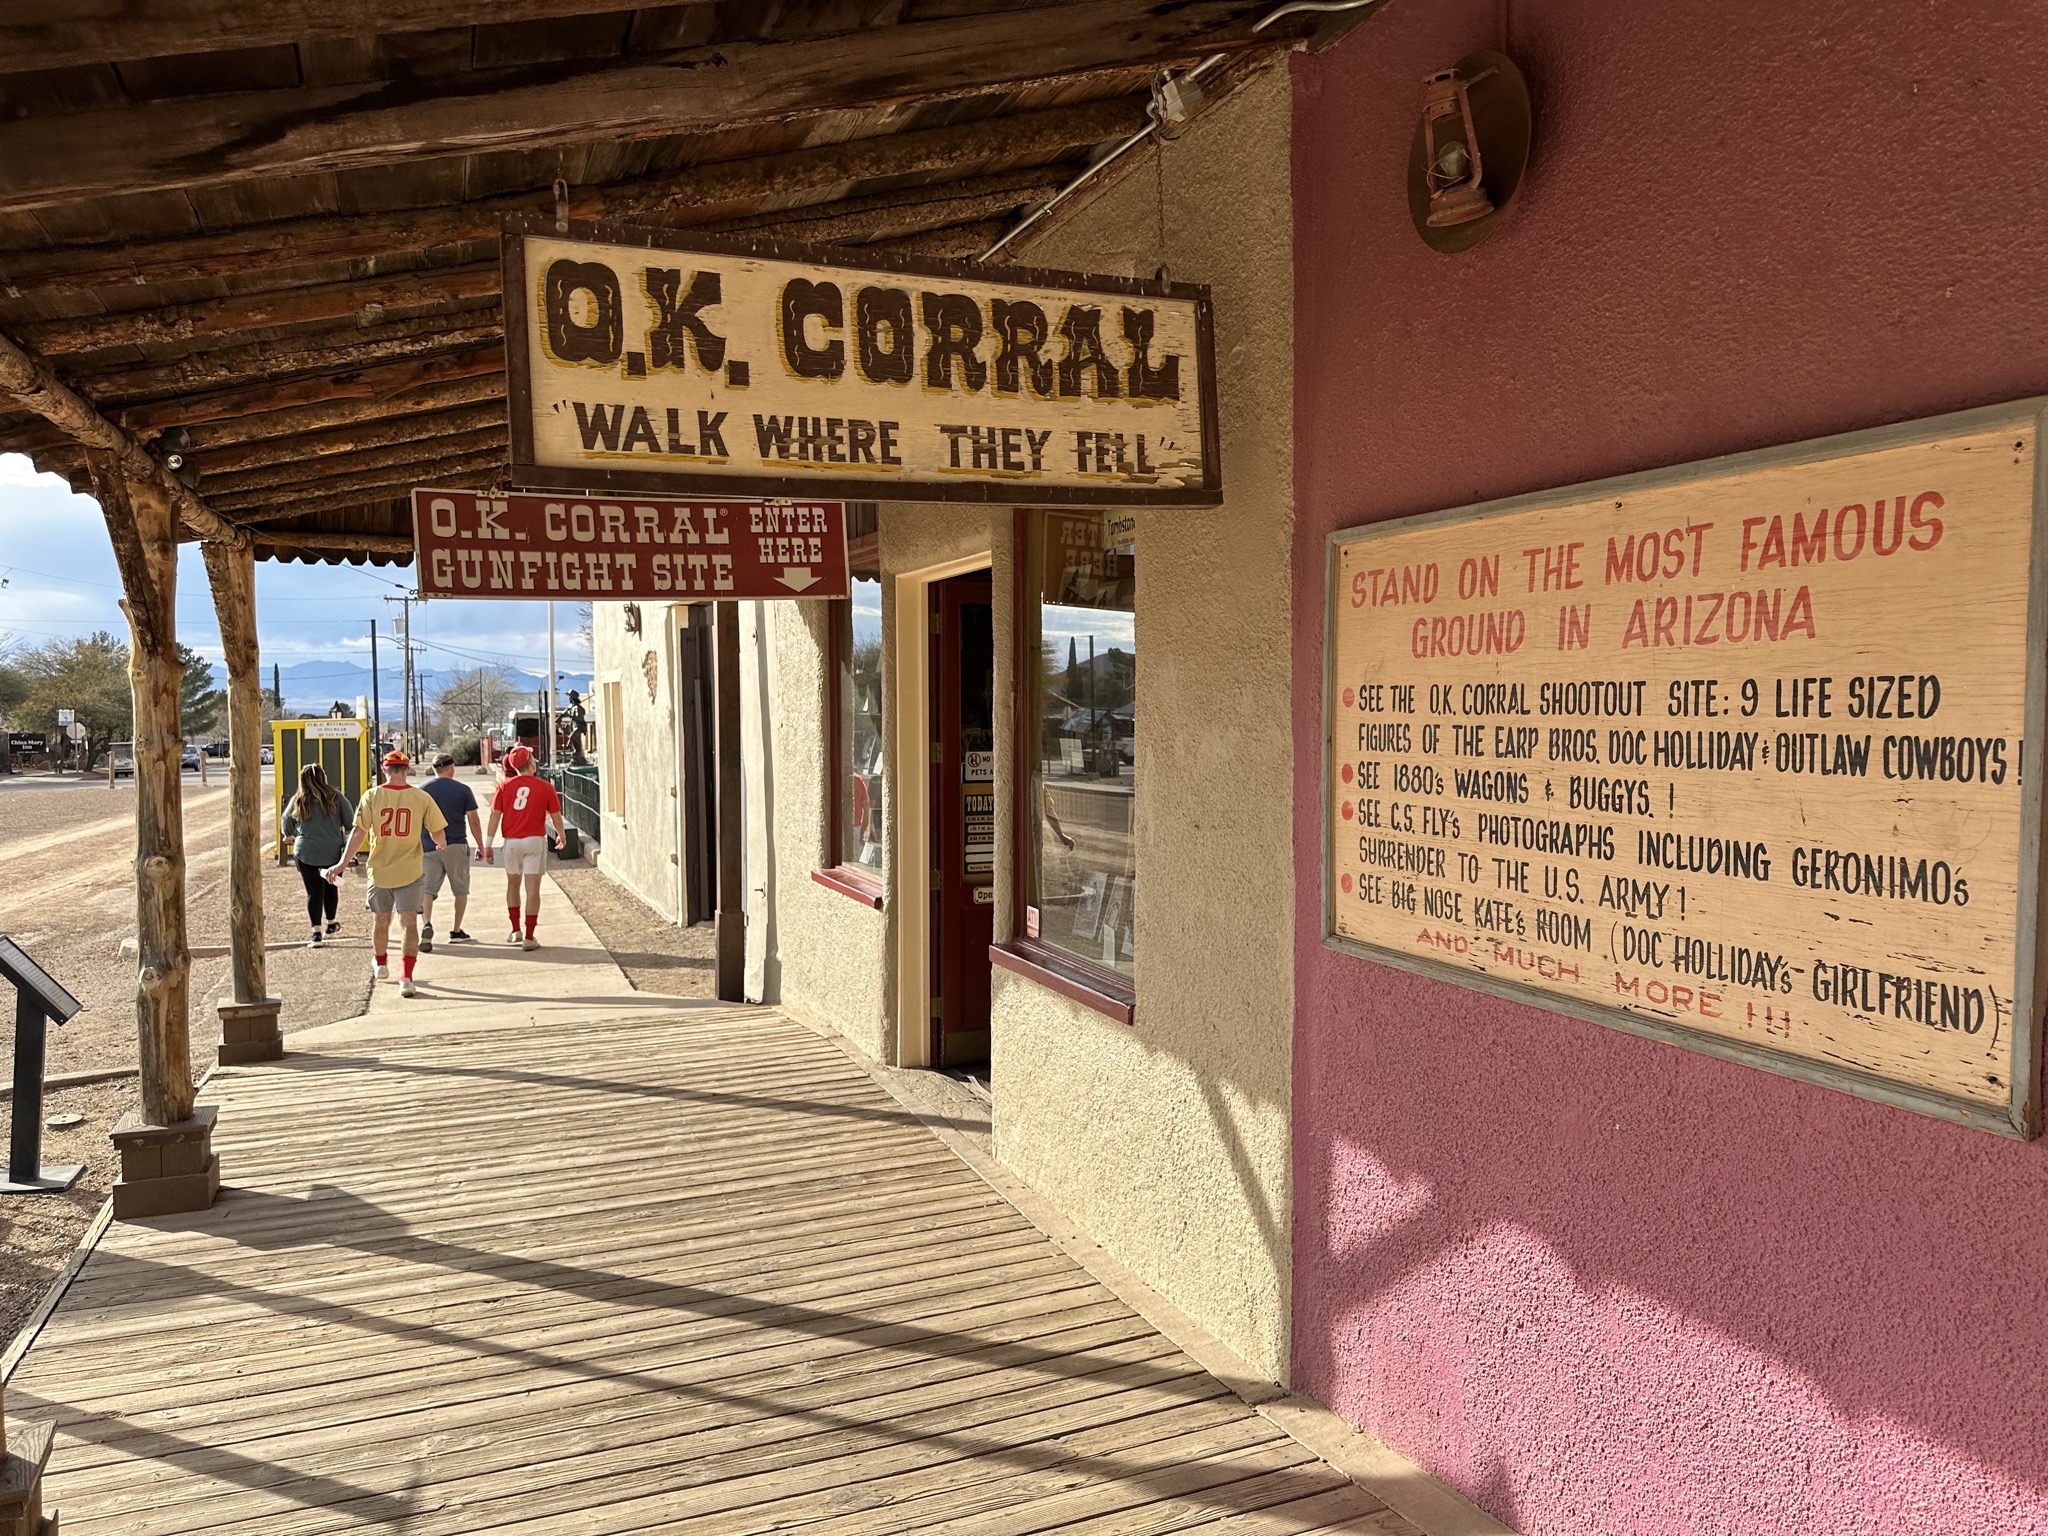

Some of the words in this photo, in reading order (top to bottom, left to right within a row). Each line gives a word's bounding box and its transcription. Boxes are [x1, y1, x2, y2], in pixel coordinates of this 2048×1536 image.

[538, 257, 750, 390] O.K.
[776, 278, 1181, 404] CORRAL
[753, 414, 901, 466] WHERE
[936, 424, 1052, 472] THEY
[430, 498, 527, 541] O.K.
[749, 507, 829, 534] ENTER
[431, 549, 638, 592] GUNFIGHT
[651, 554, 735, 592] SITE
[758, 537, 823, 564] HERE
[1351, 562, 1439, 609] STAND
[1458, 554, 1500, 600] ON
[1523, 542, 1584, 593] THE
[1605, 522, 1714, 585] MOST
[1740, 491, 1945, 572] FAMOUS
[1411, 609, 1526, 659] GROUND
[1558, 603, 1591, 650] IN
[1621, 585, 1817, 649] ARIZONA
[1358, 684, 1384, 712] SEE
[1390, 684, 1415, 713] THE
[1429, 683, 1457, 716] O.K.
[1462, 683, 1531, 716] CORRAL
[1539, 681, 1646, 716] SHOOTOUT
[1667, 680, 1729, 717] SITE:
[1741, 678, 1759, 717] 9
[1776, 677, 1832, 718] LIFE
[1848, 675, 1941, 719] SIZED
[1358, 723, 1412, 754] FIGURES
[1422, 723, 1440, 754] OF
[1452, 724, 1485, 757] THE
[1495, 725, 1539, 759] EARP
[1548, 727, 1600, 764] BROS.
[1609, 729, 1647, 765] DOC
[1653, 730, 1759, 771] HOLLIDAY
[1776, 732, 1871, 777] OUTLAW
[513, 786, 530, 811] 8
[966, 796, 994, 812] TODAY
[1358, 760, 1381, 789] SEE
[1394, 763, 1444, 795] 1880's
[1454, 768, 1529, 803] WAGONS
[380, 808, 411, 837] 20
[1358, 798, 1381, 828] SEE
[1390, 802, 1416, 834] C.S.
[1423, 806, 1460, 839] FLY's
[1478, 813, 1615, 861] PHOTOGRAPHS
[1638, 830, 1771, 881] INCLUDING
[1792, 847, 1969, 907] GERONIMO's
[1359, 835, 1446, 878] SURRENDER
[1458, 852, 1480, 884] TO
[1492, 857, 1529, 893] THE
[1544, 864, 1584, 904] U.S.
[1359, 872, 1383, 905] SEE
[1391, 880, 1416, 913] BIG
[1424, 886, 1463, 923] NOSE
[1474, 897, 1526, 936] KATE's
[1536, 908, 1591, 953] ROOM
[1610, 920, 1663, 969] (DOC
[1812, 960, 1999, 1050] GIRLFRIEND)
[1416, 927, 1469, 954] AND
[1494, 943, 1579, 983] MUCH
[1615, 971, 1723, 1018] MORE
